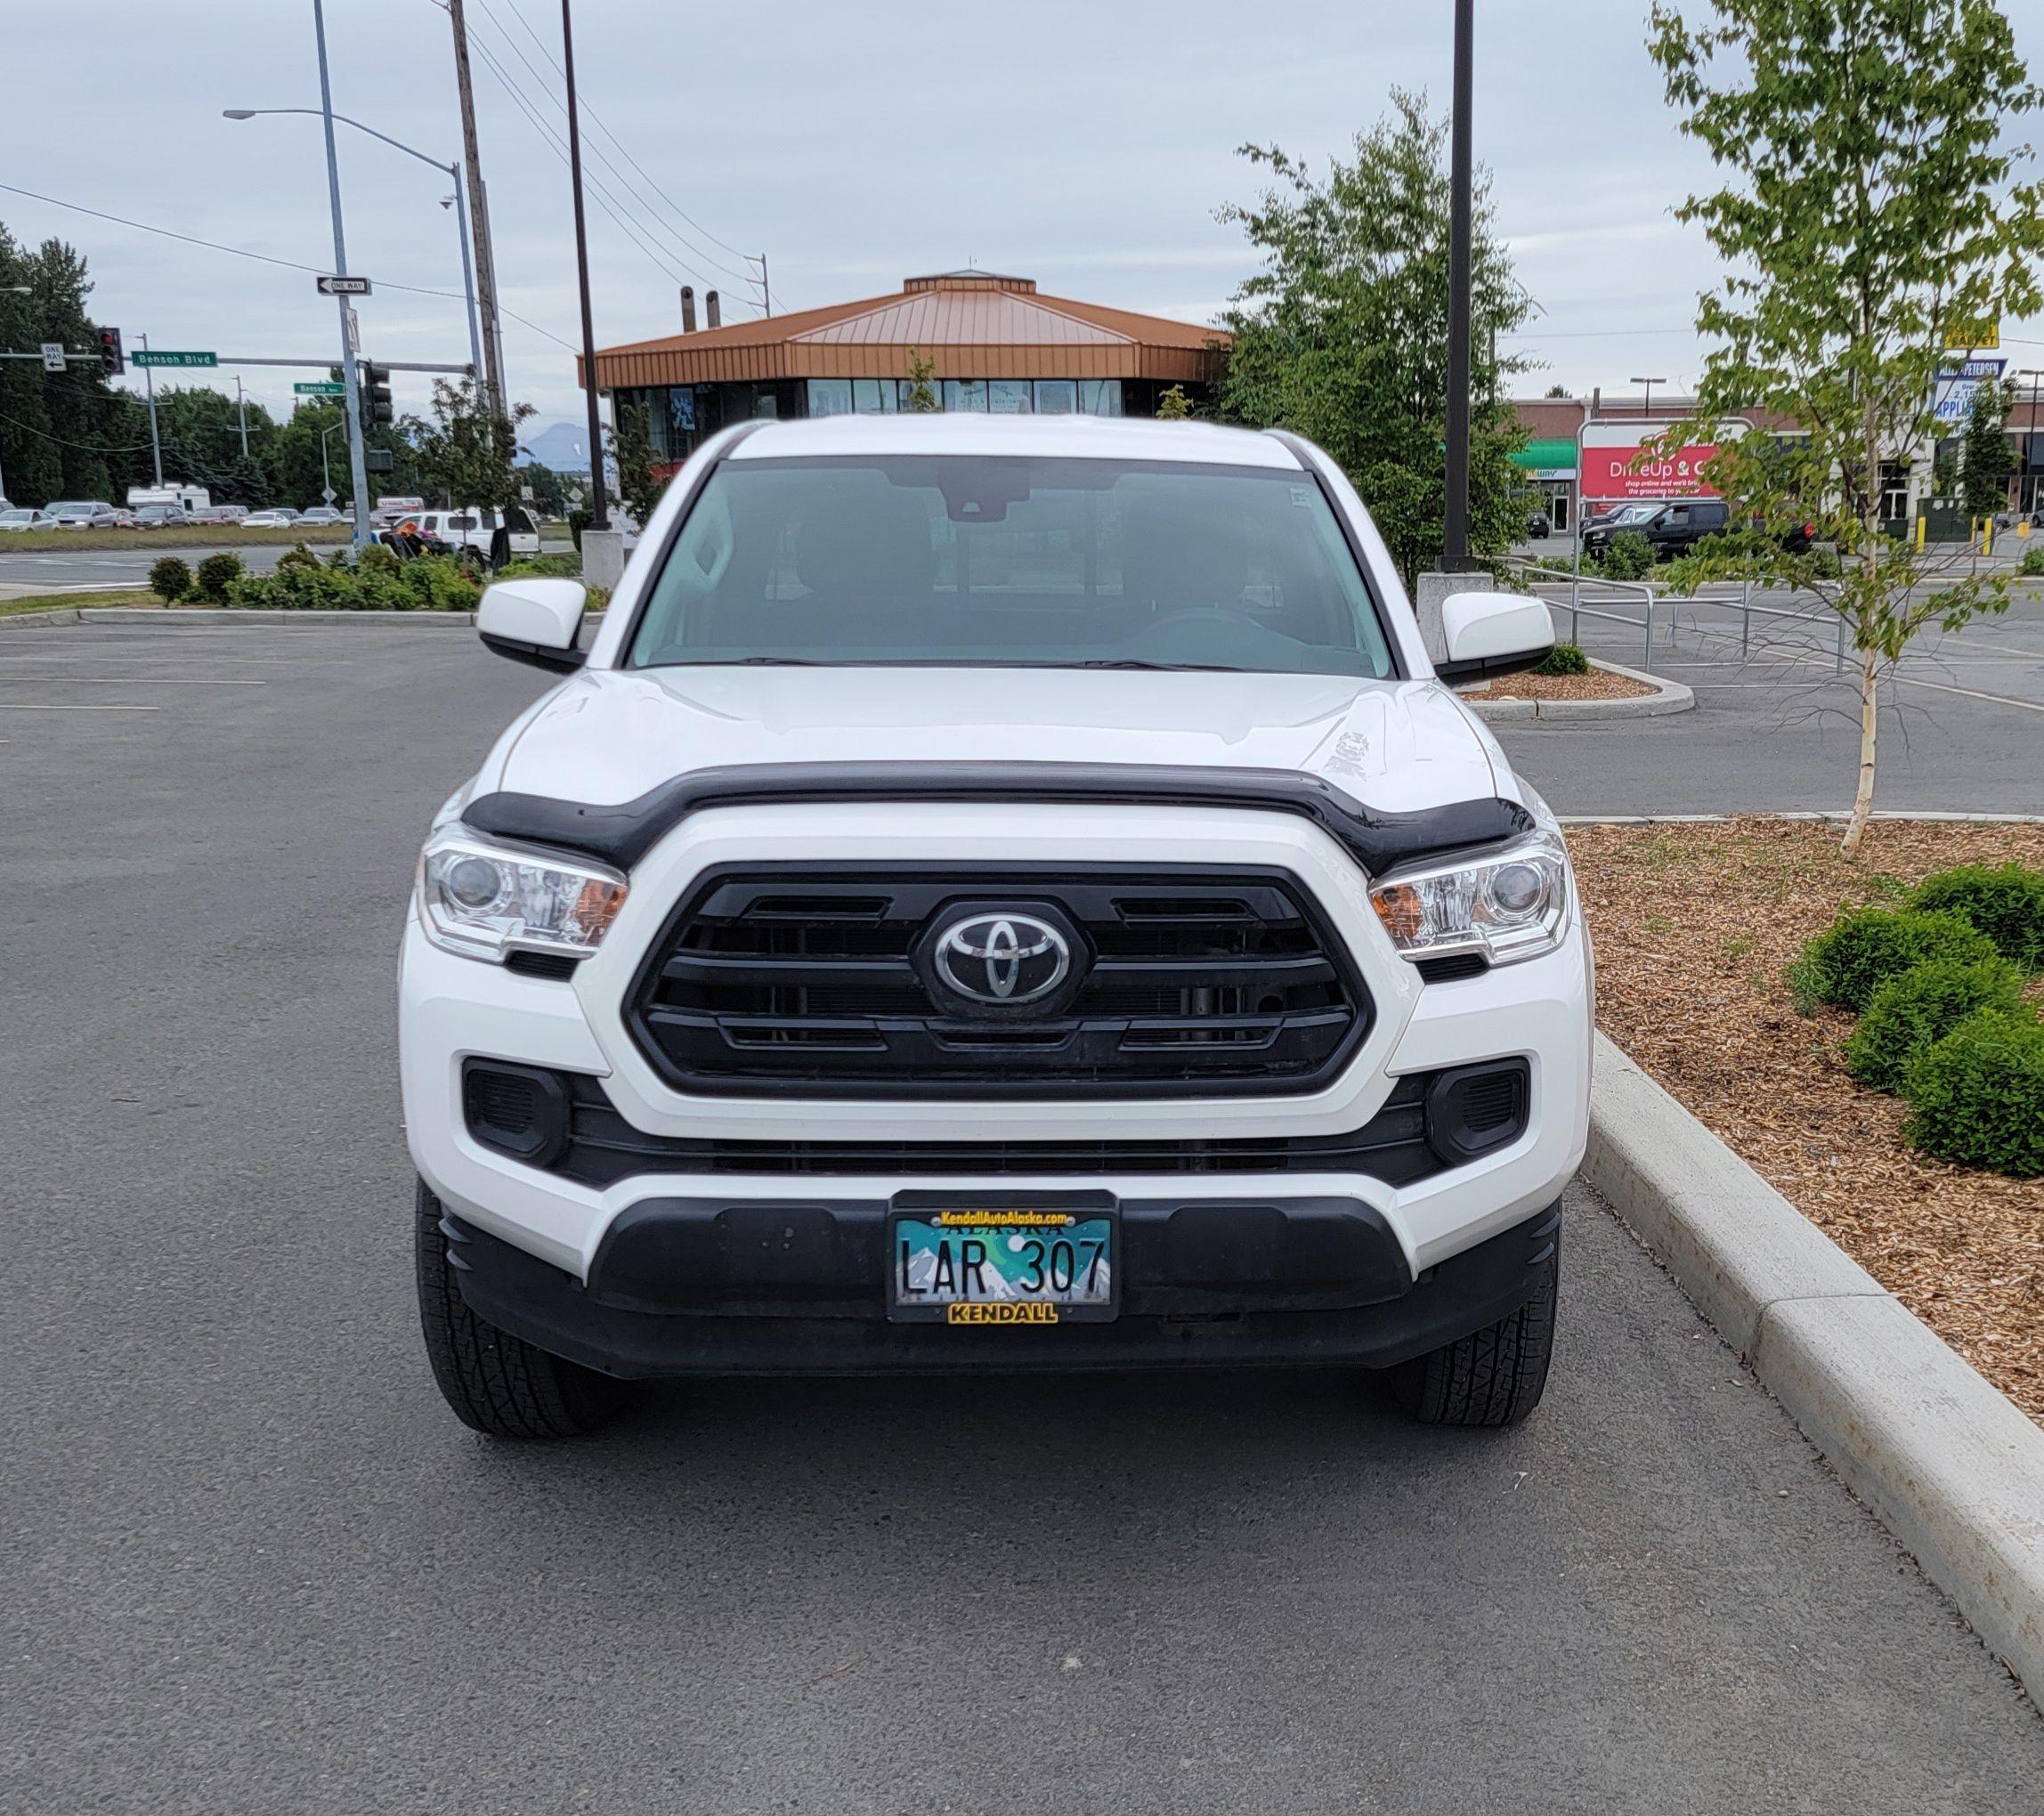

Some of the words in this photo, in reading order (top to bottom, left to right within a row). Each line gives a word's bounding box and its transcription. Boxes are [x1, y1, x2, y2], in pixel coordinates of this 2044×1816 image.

[331, 281, 345, 289] ONE
[347, 281, 362, 289] WAY
[45, 345, 61, 353] ONE
[46, 353, 62, 361] WAY
[139, 354, 178, 364] Benson
[184, 355, 211, 364] Blvd
[1677, 460, 1690, 475] &
[1625, 480, 1640, 488] shop
[1639, 488, 1667, 496] groceries
[941, 1210, 1067, 1225] KendallAutoAlaska.com
[902, 1239, 987, 1294] LAR
[1021, 1238, 1106, 1293] 307
[950, 1304, 1058, 1322] KENDALL
